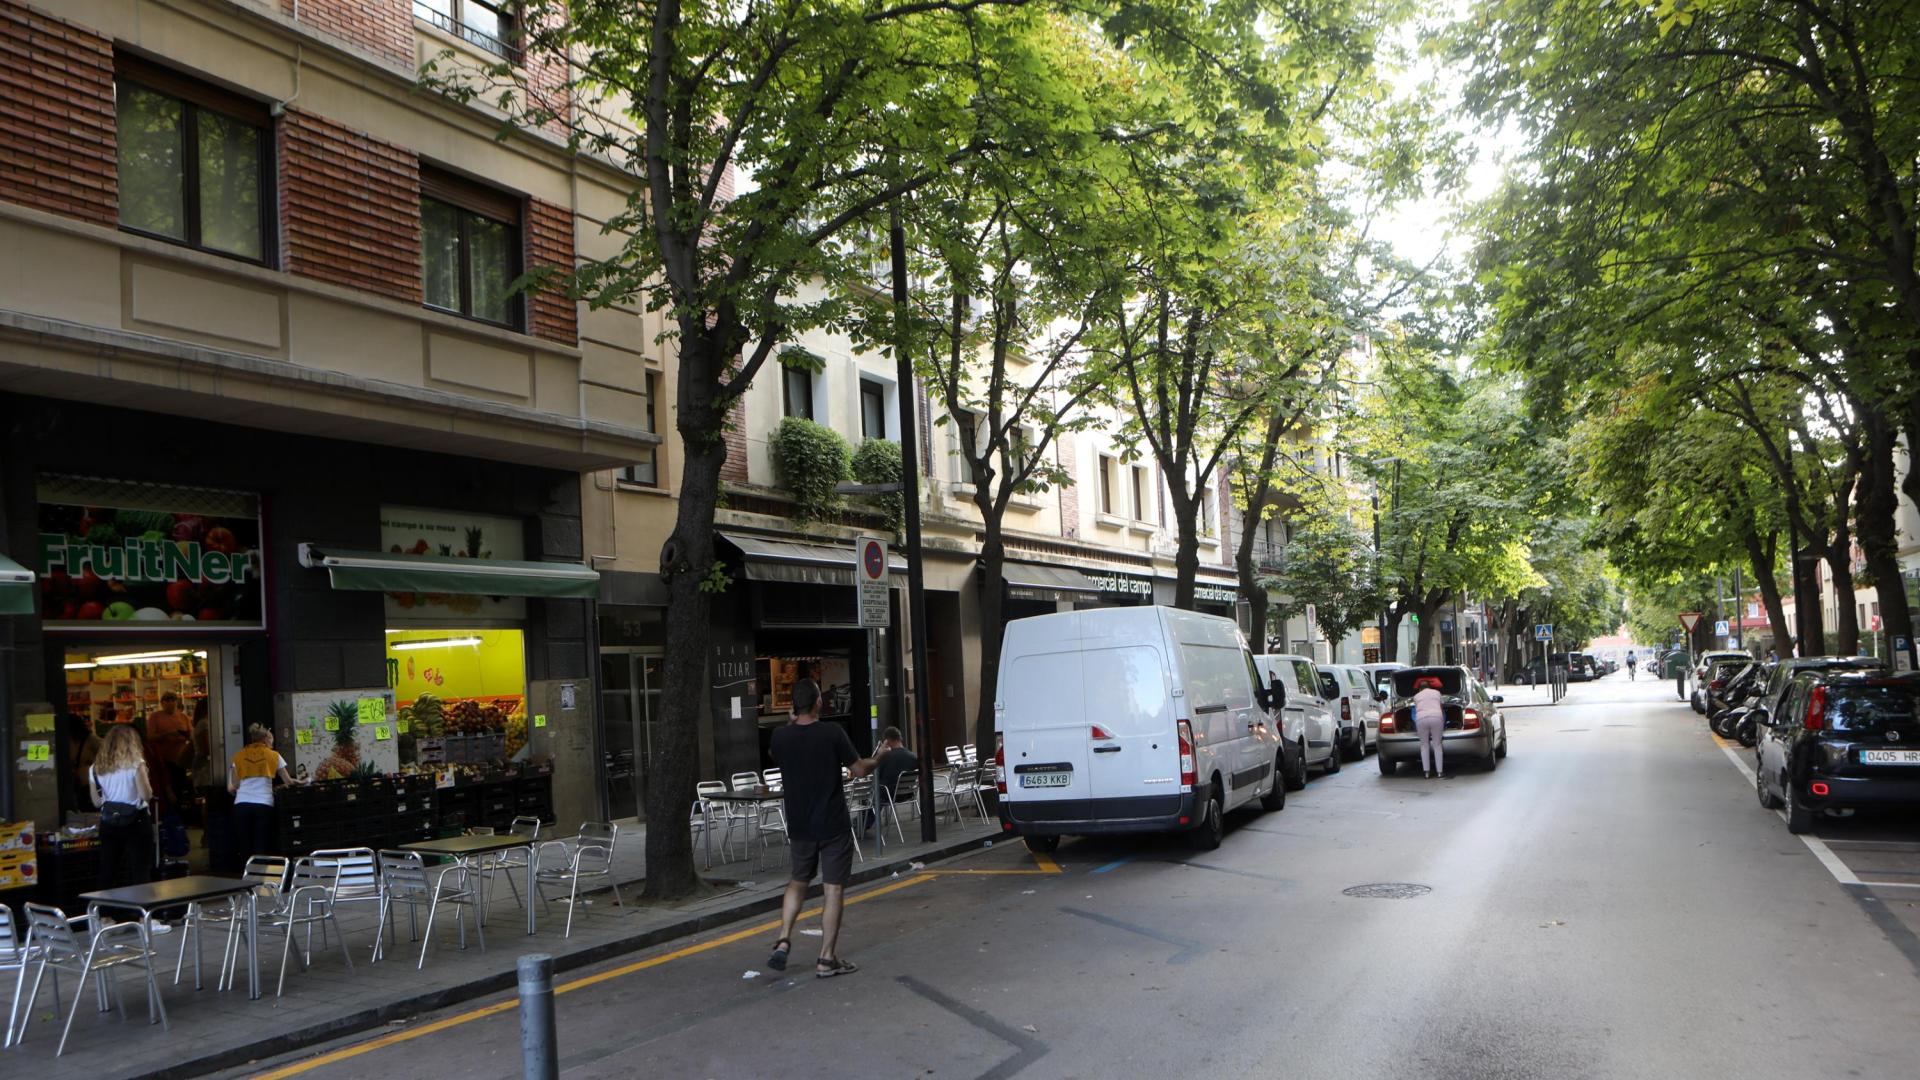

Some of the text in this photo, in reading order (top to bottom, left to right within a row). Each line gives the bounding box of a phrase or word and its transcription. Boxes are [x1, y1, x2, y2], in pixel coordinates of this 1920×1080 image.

[391, 521, 417, 530] campo
[436, 525, 456, 533] mesa
[40, 533, 251, 584] FruitNer
[1118, 573, 1129, 592] del
[1129, 580, 1152, 600] campo
[623, 621, 641, 638] 53
[1896, 638, 1905, 649] P
[717, 661, 750, 678] ITZIAR
[1867, 751, 1920, 762] 0405 HR
[1026, 774, 1068, 785] 6463 KKB
